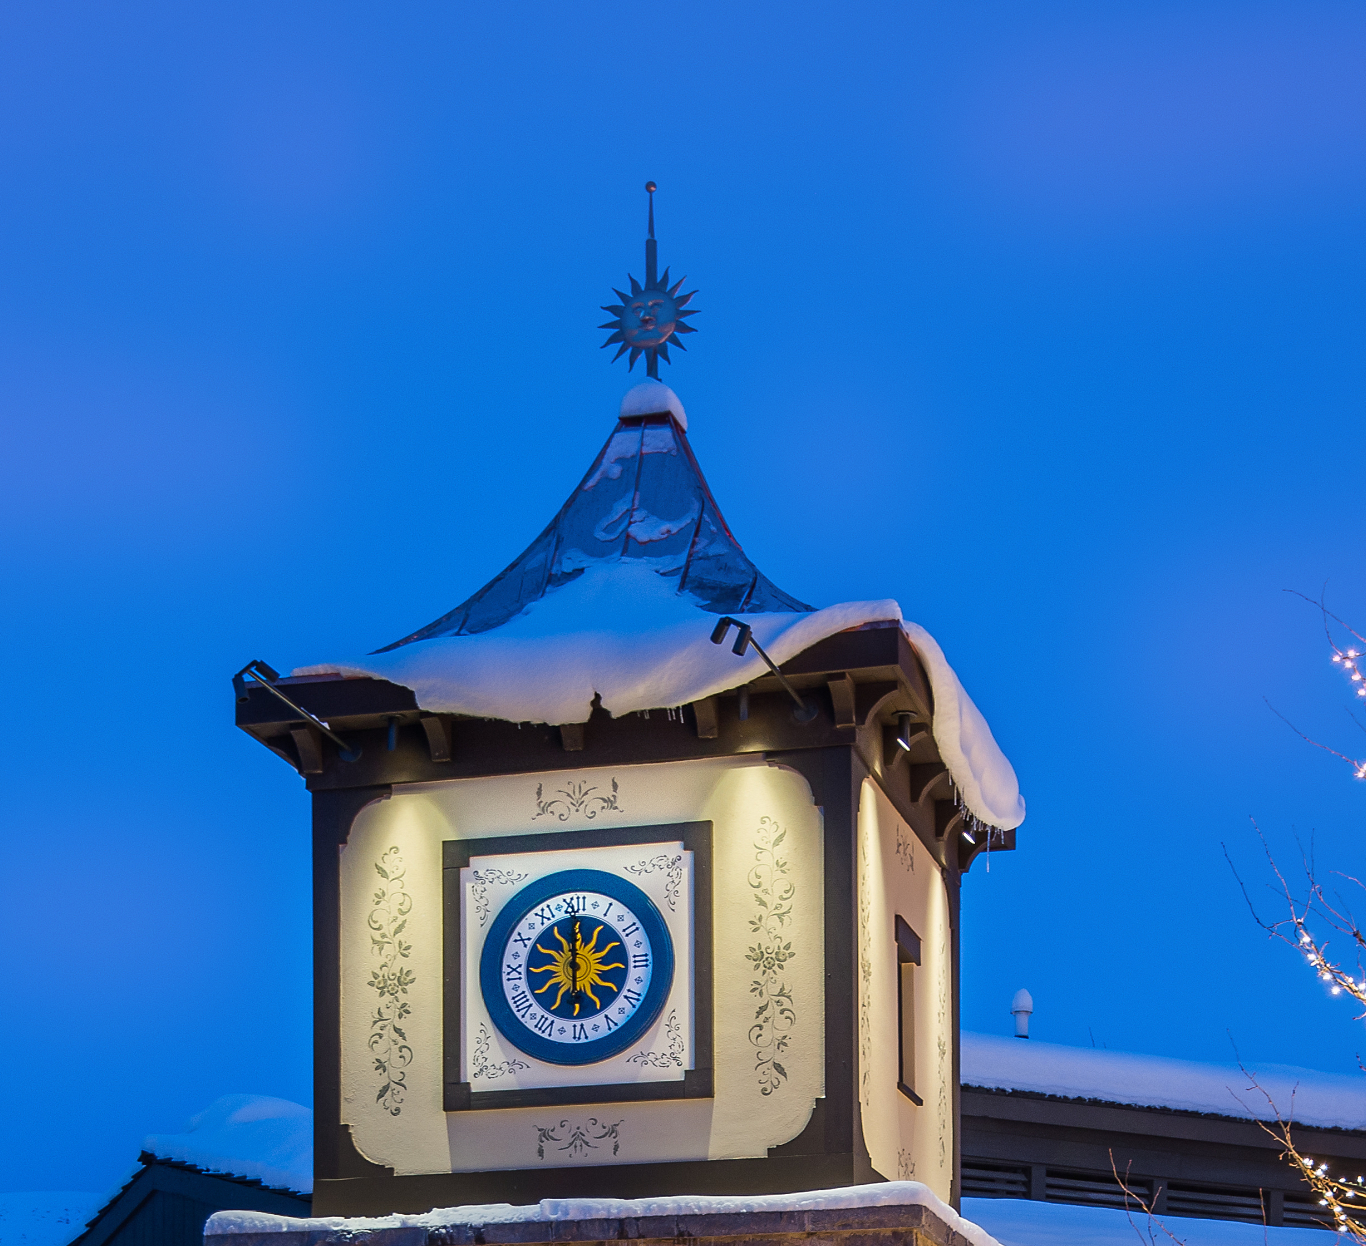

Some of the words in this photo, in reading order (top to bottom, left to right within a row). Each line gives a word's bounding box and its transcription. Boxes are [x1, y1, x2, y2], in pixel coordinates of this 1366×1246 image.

[562, 896, 587, 914] XII
[603, 902, 614, 917] I
[534, 904, 556, 926] XI
[622, 921, 640, 938] II
[513, 932, 532, 948] X
[632, 953, 650, 969] III
[506, 963, 523, 982] IX
[511, 990, 534, 1019] VIII
[623, 988, 642, 1009] IV
[534, 1014, 555, 1038] VII
[604, 1013, 619, 1032] V
[572, 1023, 589, 1041] VI
